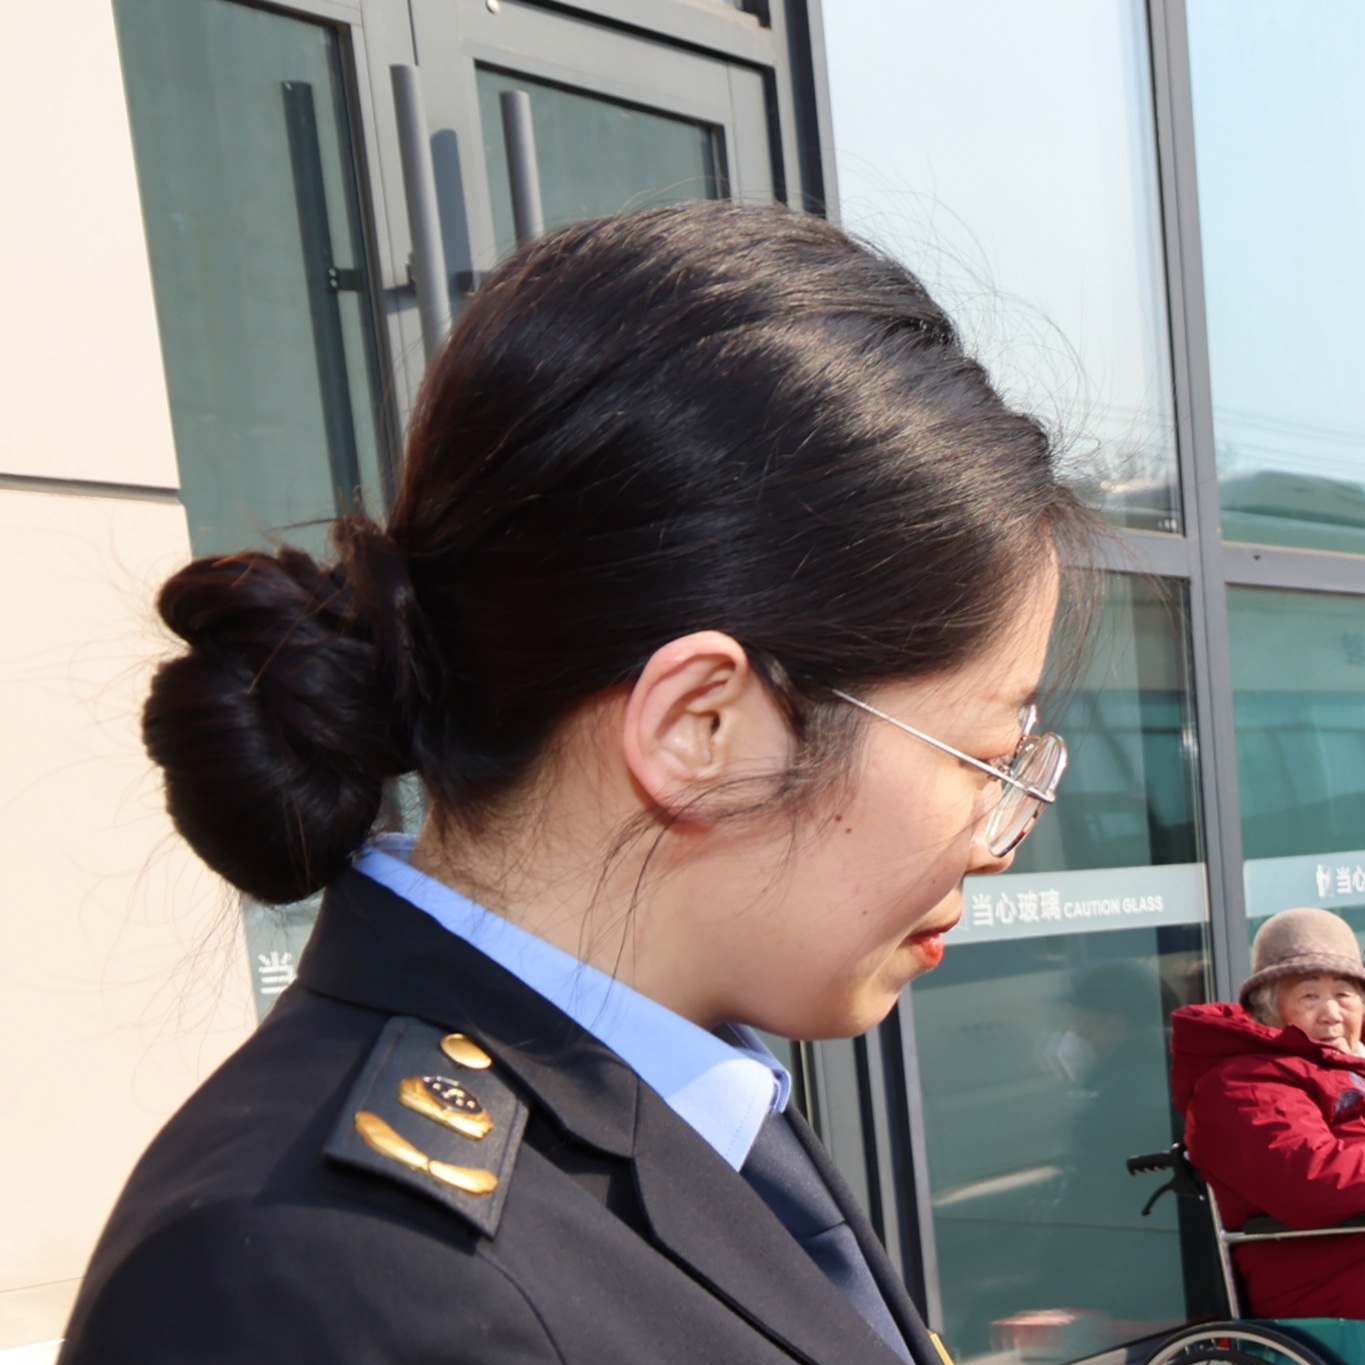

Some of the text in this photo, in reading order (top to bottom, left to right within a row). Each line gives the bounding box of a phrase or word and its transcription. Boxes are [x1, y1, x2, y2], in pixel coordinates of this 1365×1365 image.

[971, 888, 1164, 927] 当心玻璃 CAUTION GLASS
